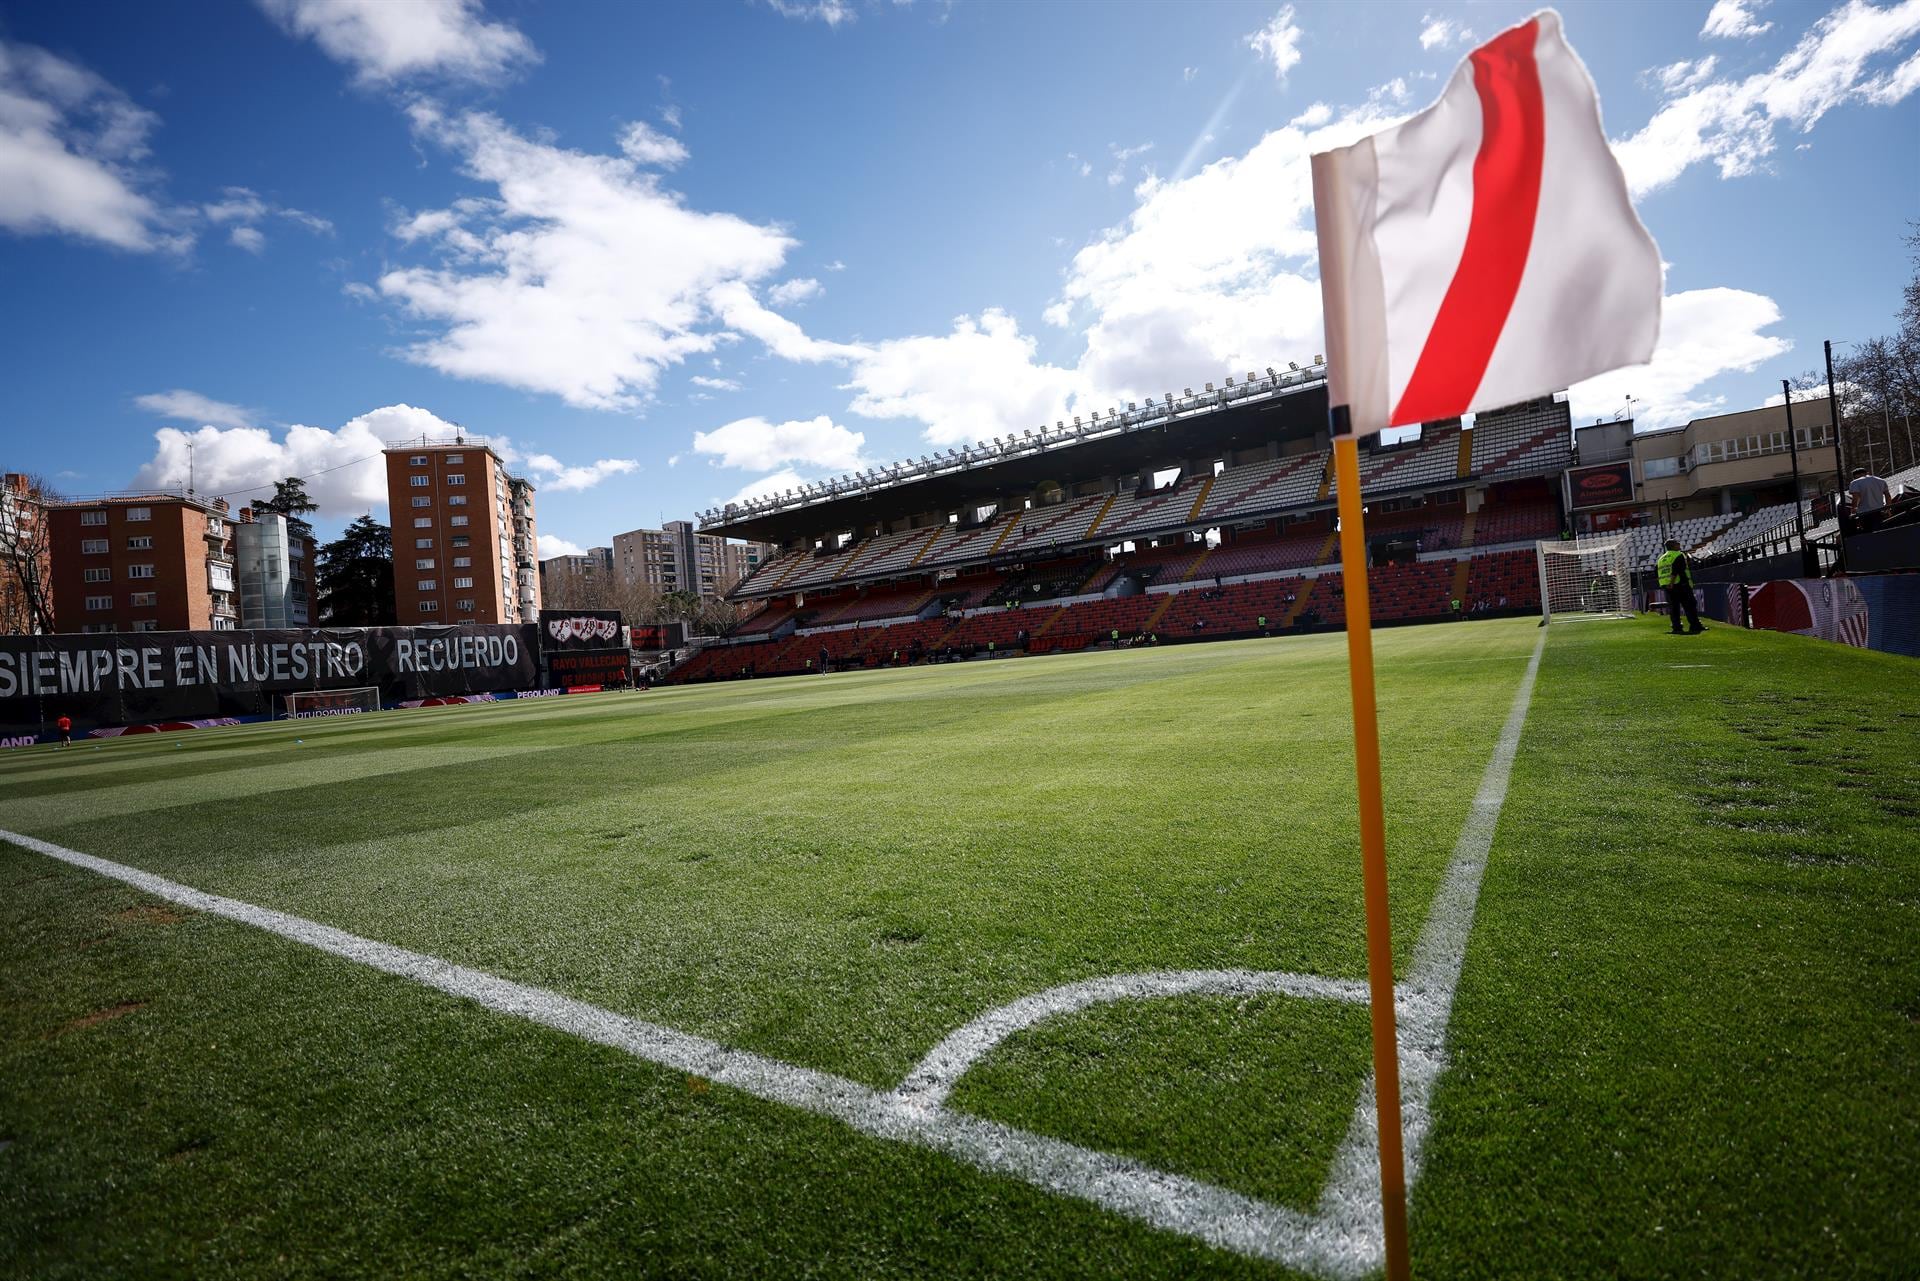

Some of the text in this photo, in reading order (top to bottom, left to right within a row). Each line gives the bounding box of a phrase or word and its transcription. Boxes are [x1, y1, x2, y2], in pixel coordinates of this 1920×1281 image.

[0, 634, 518, 698] SIEMPRE EN NUESTRO RECUERDO
[552, 655, 628, 671] RAYO VALLECANO
[562, 674, 573, 686] DE
[517, 688, 560, 699] PEGOLAND
